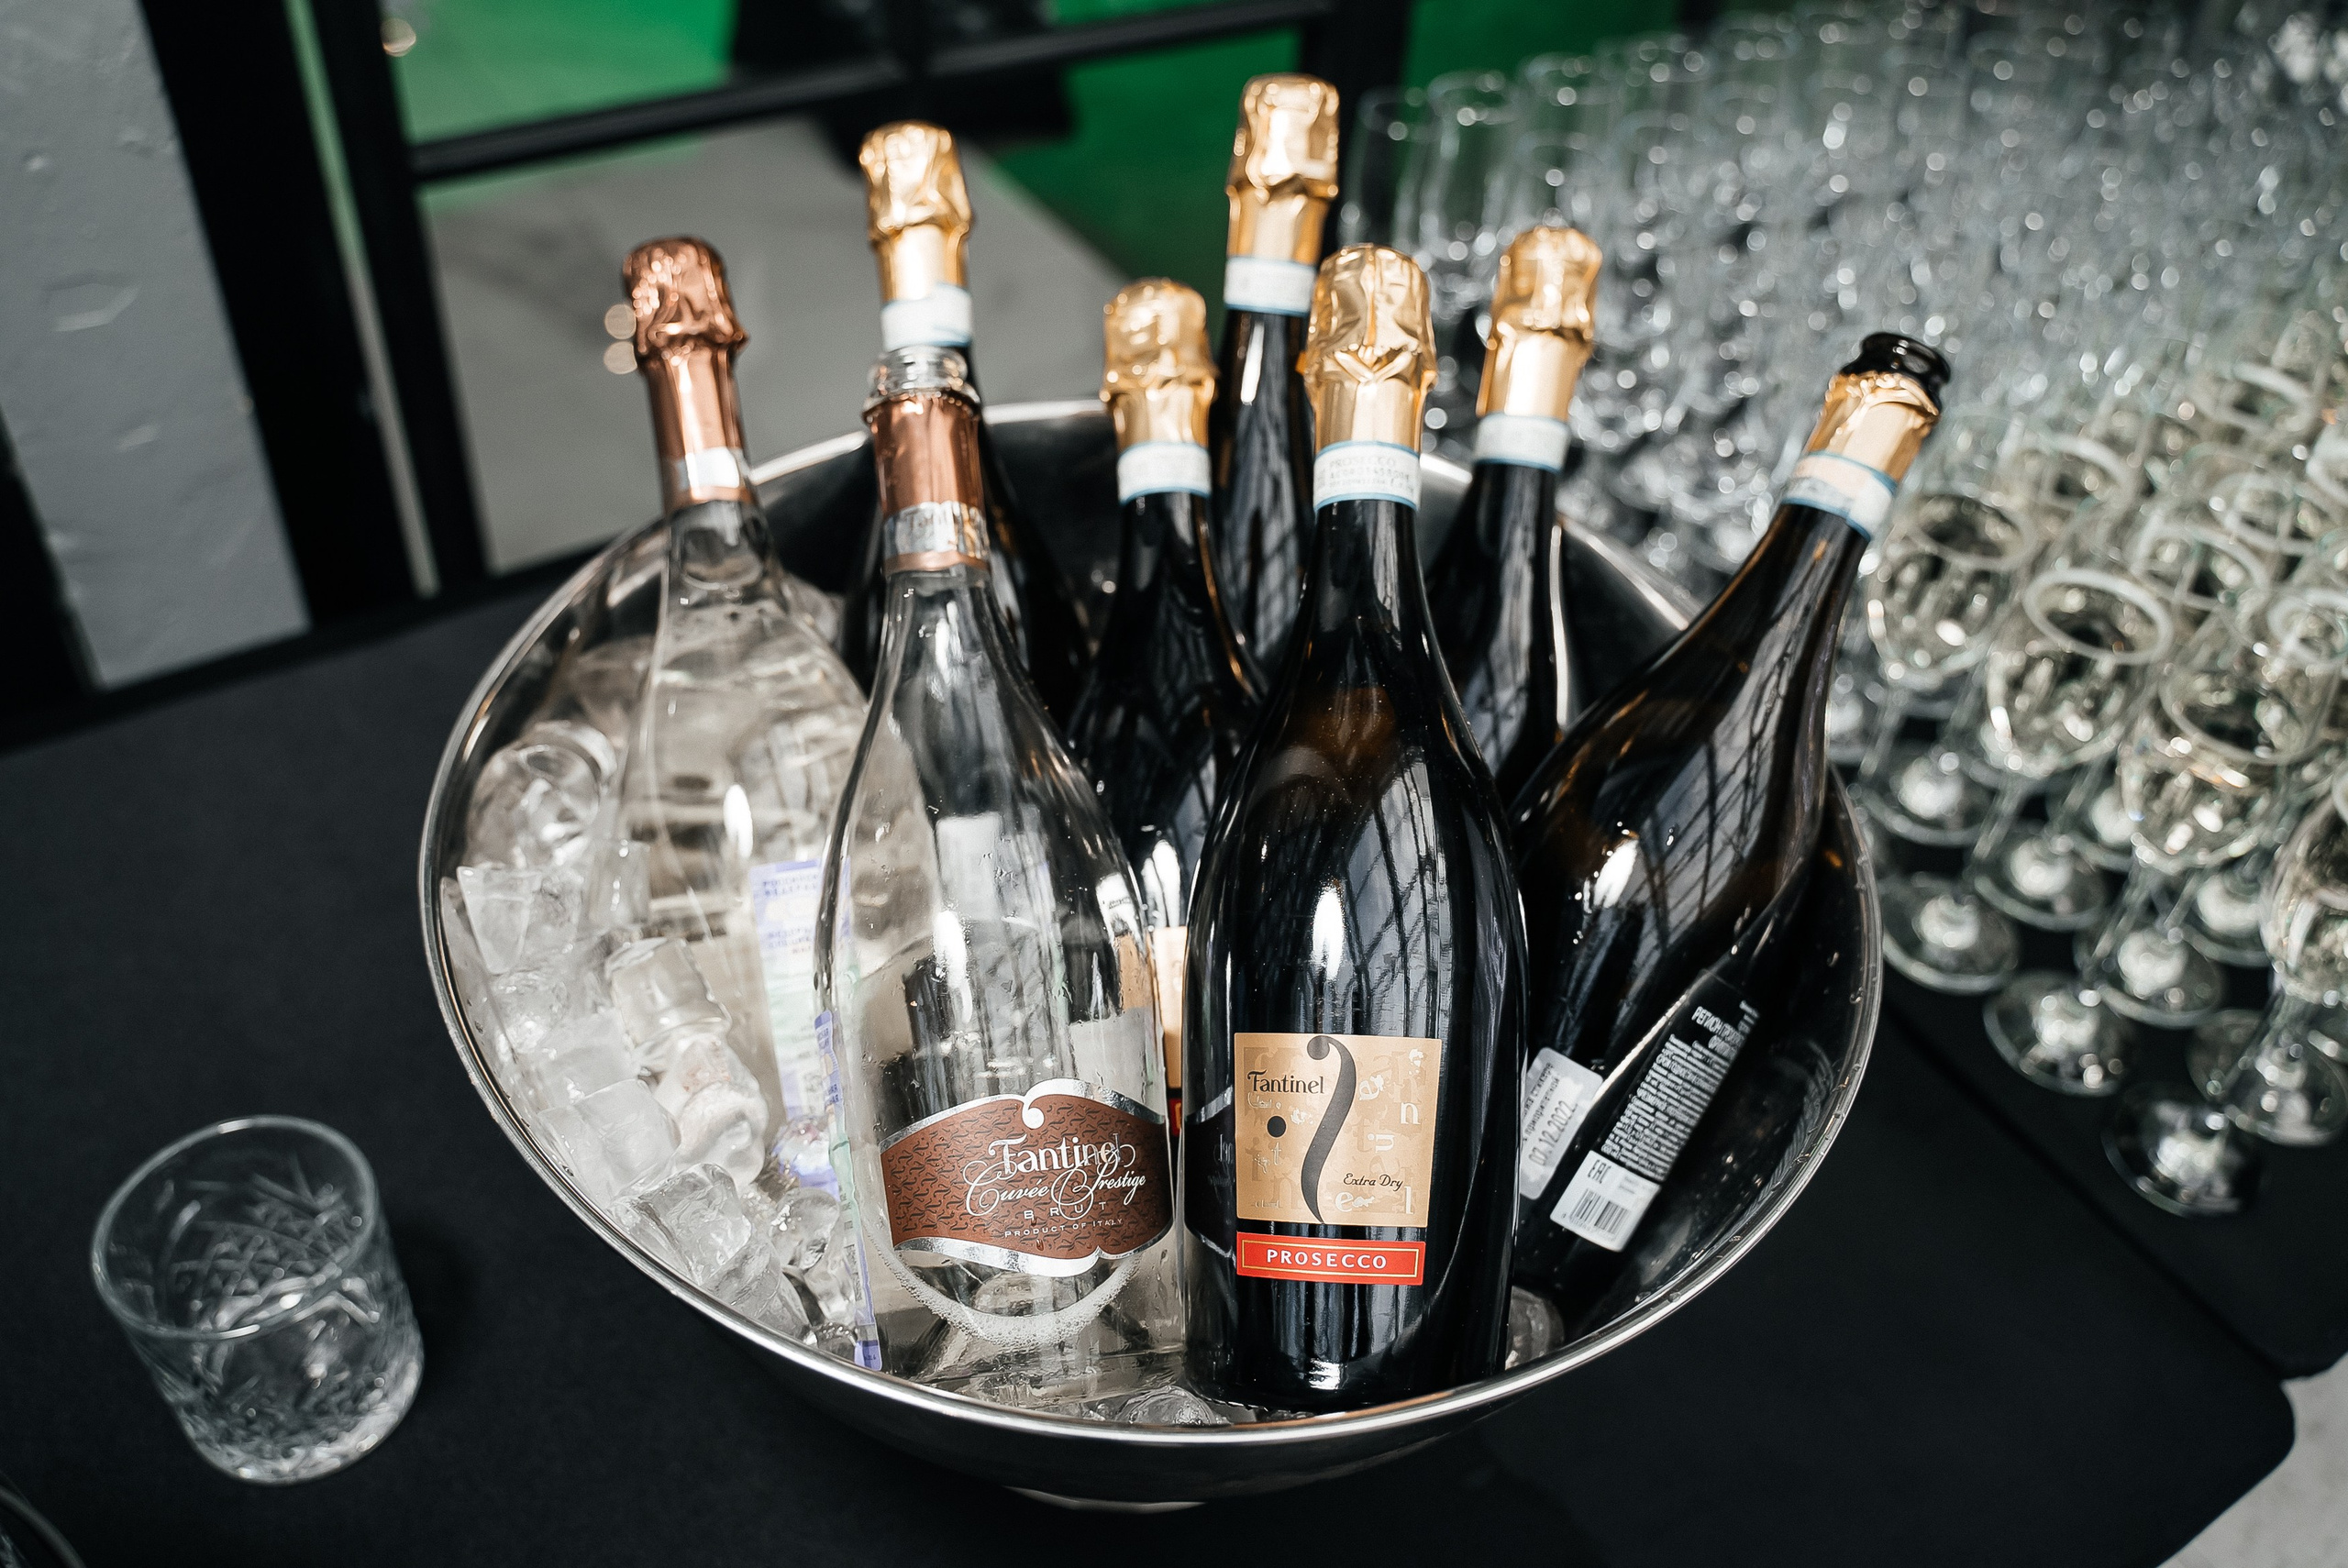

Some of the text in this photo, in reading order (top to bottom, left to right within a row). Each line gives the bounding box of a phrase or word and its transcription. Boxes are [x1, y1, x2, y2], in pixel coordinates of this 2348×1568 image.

[1247, 1069, 1324, 1094] Fantinel
[989, 1132, 1122, 1175] Fantinel
[963, 1160, 1050, 1216] Cuvée
[1051, 1144, 1146, 1220] Prestige
[1343, 1173, 1403, 1191] Extra Dry
[1024, 1201, 1107, 1220] BRUT
[1004, 1219, 1123, 1238] PRODUCT OF ITALY
[1267, 1249, 1387, 1269] PROSECCO
